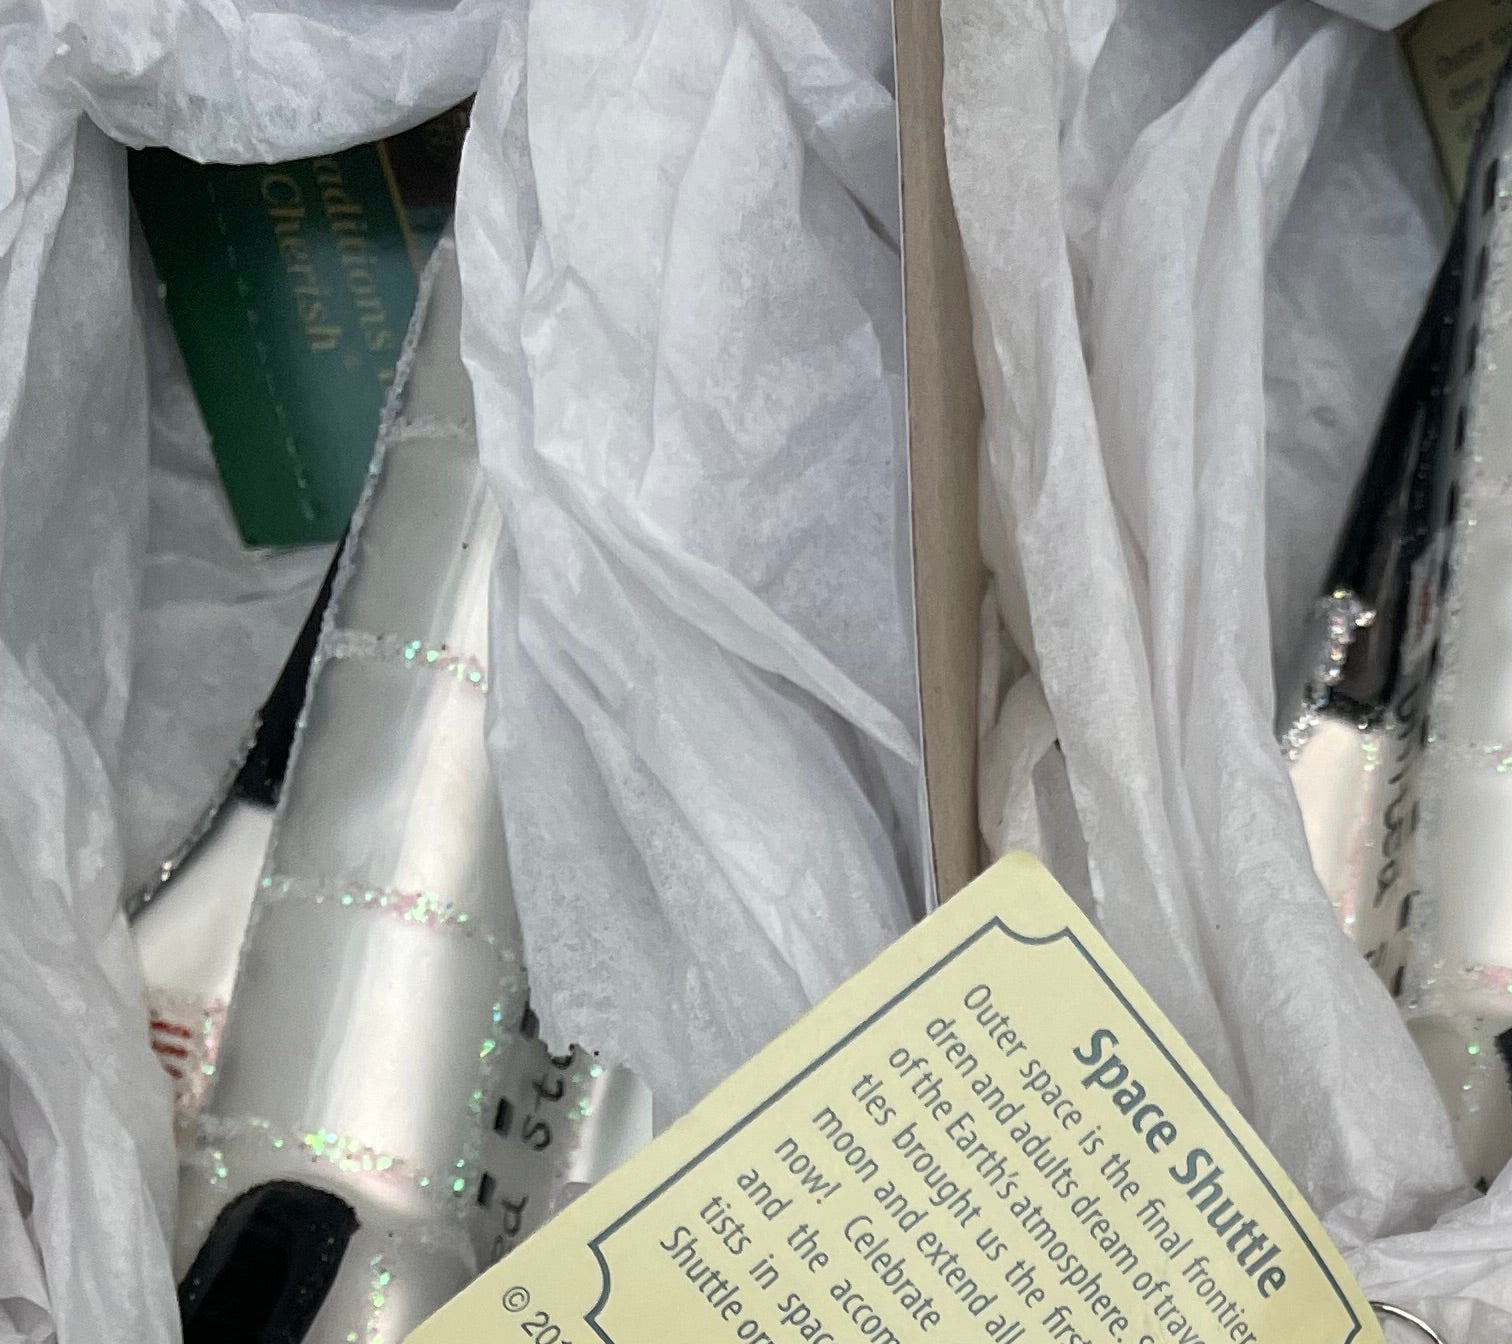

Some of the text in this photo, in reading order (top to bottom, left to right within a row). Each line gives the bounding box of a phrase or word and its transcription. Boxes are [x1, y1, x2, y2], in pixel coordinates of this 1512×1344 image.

[261, 172, 343, 352] Cherish
[736, 1168, 794, 1221] and
[786, 1223, 829, 1274] the
[812, 1106, 879, 1183] moon
[873, 1180, 929, 1233] and
[916, 1231, 999, 1317] extend
[851, 1073, 897, 1126] tles
[891, 1121, 982, 1229] brought
[975, 1227, 1009, 1262] us
[1004, 1259, 1045, 1309] the
[888, 1047, 929, 1079] of
[911, 1071, 953, 1122] the
[1009, 1195, 1129, 1344] atmosphere.
[926, 1017, 979, 1079] dren
[971, 1073, 1026, 1126] and
[1010, 1121, 1079, 1199] adults
[1070, 1195, 1139, 1276] dream
[1132, 1271, 1171, 1301] of
[963, 983, 1027, 1058] Outer
[1018, 1058, 1082, 1131] space
[1077, 1124, 1105, 1156] is
[1100, 1153, 1140, 1203] the
[1135, 1198, 1194, 1261] final
[1072, 1028, 1287, 1299] Space Shuttle
[659, 1225, 743, 1322] Shuttle
[699, 1195, 753, 1256] tists
[748, 1253, 779, 1290] in
[774, 1137, 842, 1205] now!
[844, 1215, 941, 1332] Celebrate
